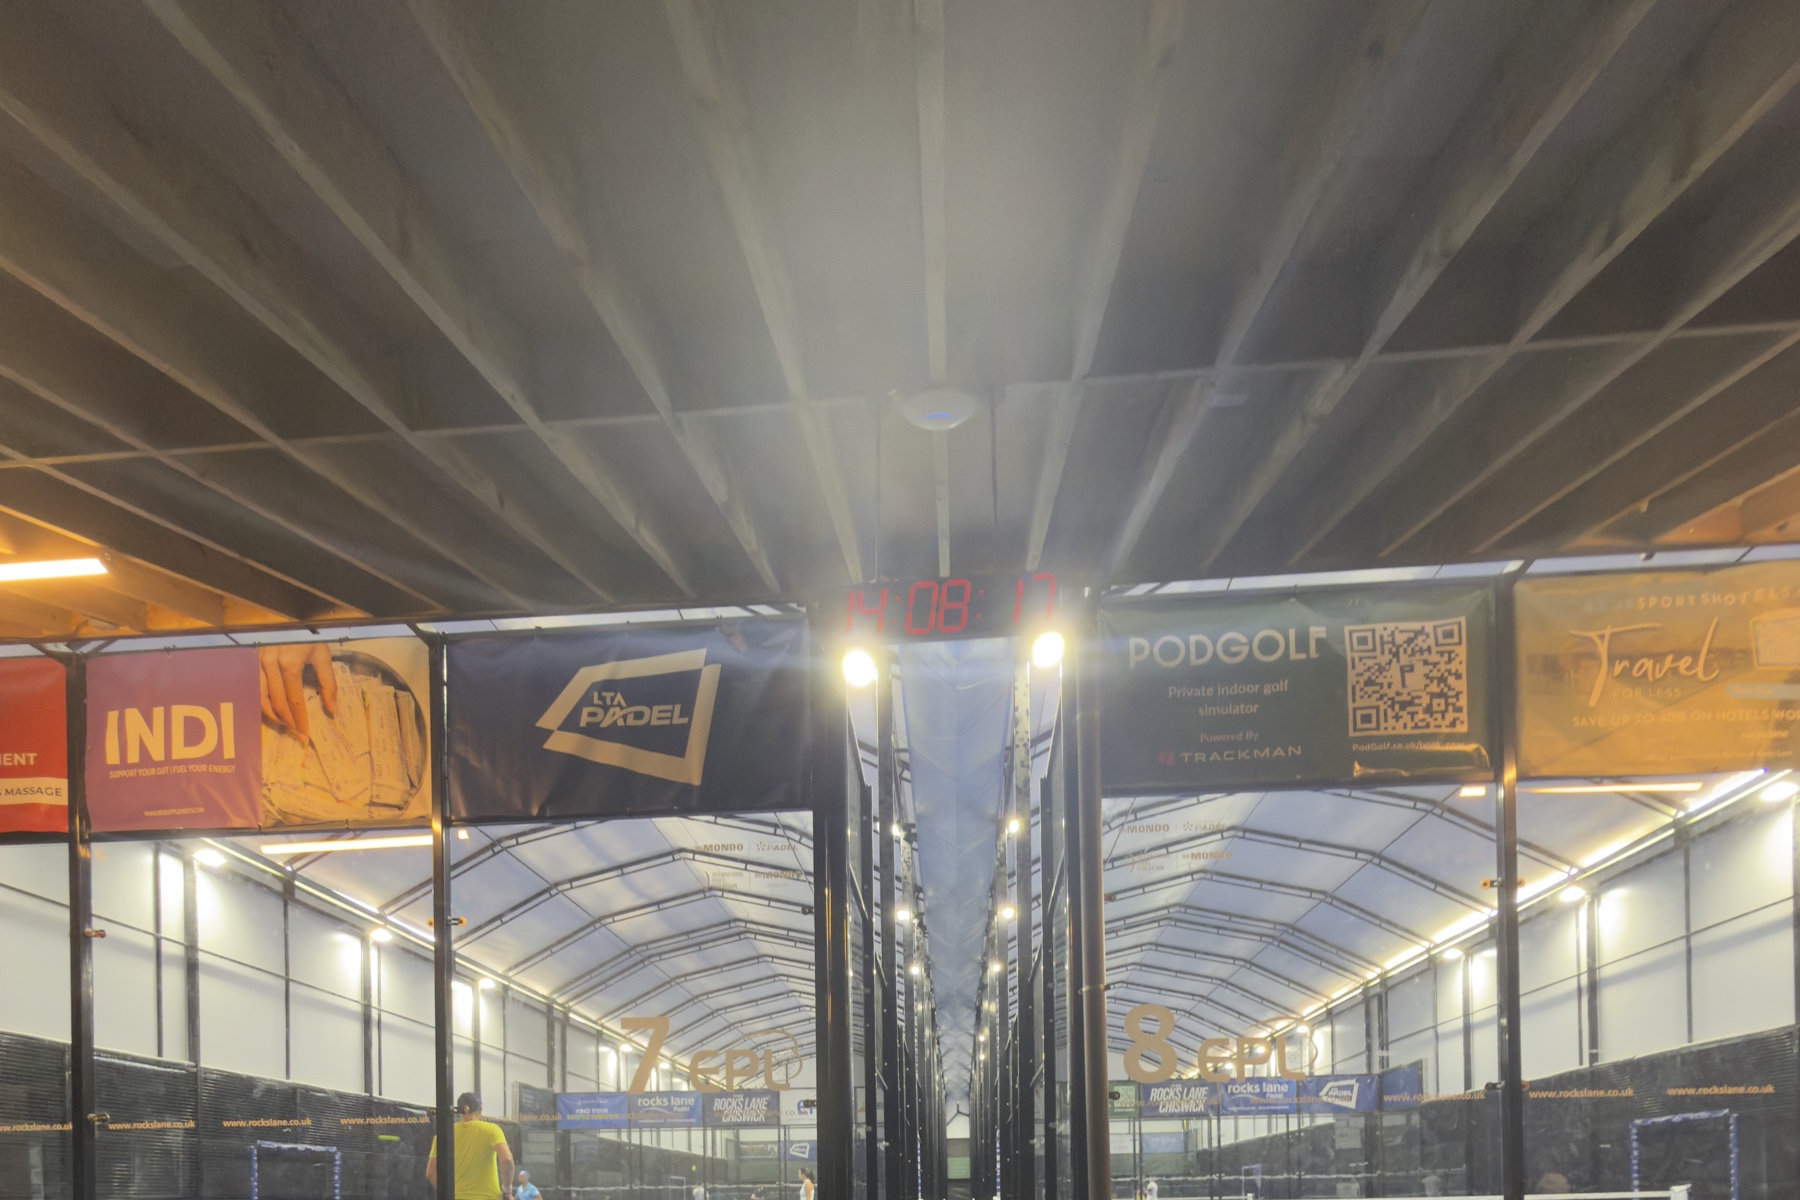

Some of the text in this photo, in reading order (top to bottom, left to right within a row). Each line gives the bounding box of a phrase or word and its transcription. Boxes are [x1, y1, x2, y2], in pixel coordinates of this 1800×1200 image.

[1128, 626, 1327, 669] PODGOLF
[1569, 617, 1720, 707] Travel
[1168, 679, 1289, 698] Private indoor golf
[593, 691, 627, 707] LTA
[580, 704, 689, 728] PADEL
[1198, 702, 1260, 716] simulator
[1573, 715, 1606, 727] SAVE
[1611, 715, 1629, 726] UP
[1633, 713, 1652, 726] TO
[1690, 709, 1712, 722] ON
[1716, 709, 1769, 722] HOTELS
[105, 702, 236, 765] INDI
[1200, 730, 1259, 743] Powered By
[0, 753, 38, 766] ENT
[1182, 744, 1302, 763] TRACKMAN
[109, 764, 236, 779] SUPPORT YOUR GUT FUEL YOUR ENERGY
[5, 787, 62, 797] MASSAGE
[1126, 823, 1169, 834] MONDO
[703, 843, 744, 852] MONDO
[1123, 1004, 1178, 1083] 8
[621, 1016, 670, 1094] 7
[1150, 1086, 1209, 1102] ROCKS LANE
[1227, 1081, 1289, 1094] rocks lane
[1529, 1087, 1634, 1099] www.rockslane.co.uk
[1666, 1083, 1775, 1095] www.rockslane.co.uk
[638, 1096, 695, 1106] rocks lane
[713, 1097, 768, 1111] ROCKS LANE
[1158, 1099, 1207, 1113] CHISWICK
[222, 1117, 312, 1127] www.rockslane.co.uk
[340, 1115, 431, 1125] www.rockslane.co.uk
[722, 1110, 766, 1123] CHISWICK
[108, 1120, 196, 1130] www.rockslane.co.uk
